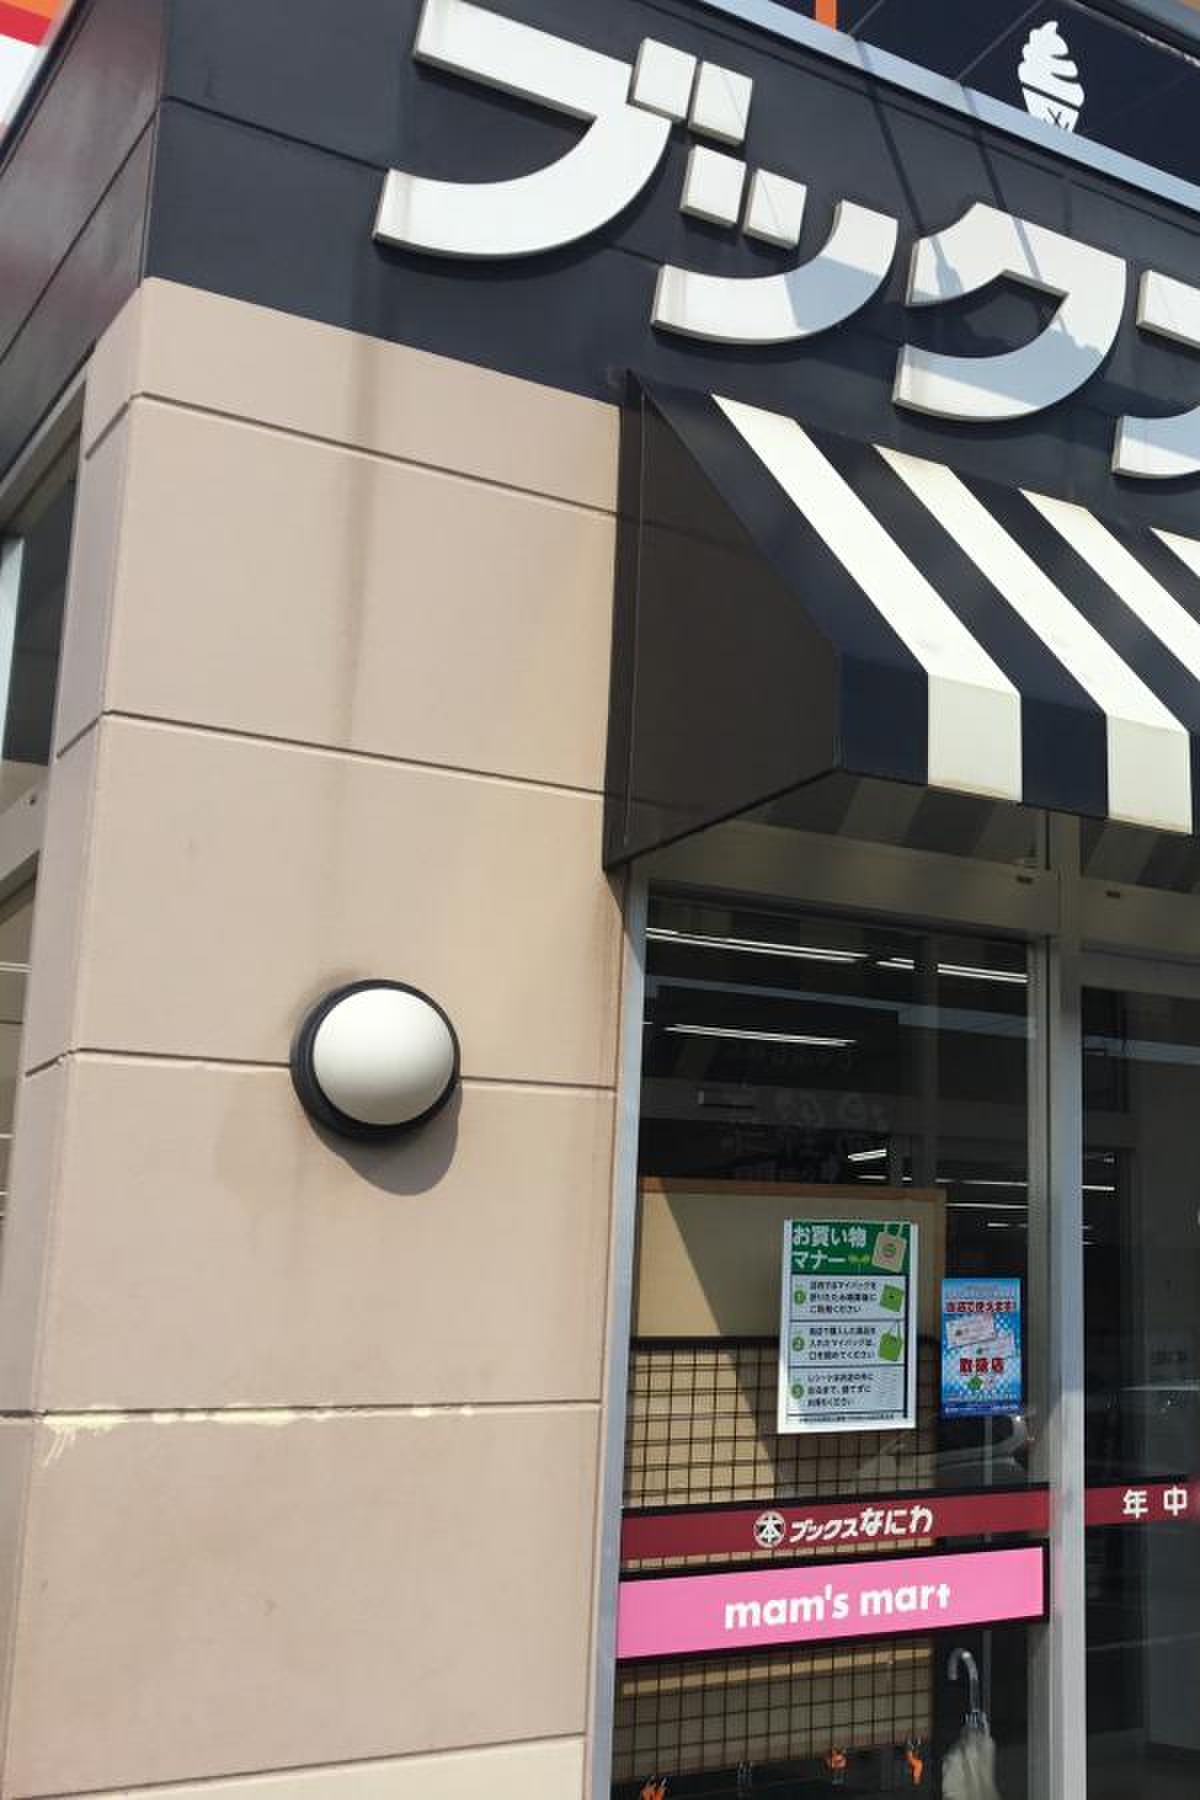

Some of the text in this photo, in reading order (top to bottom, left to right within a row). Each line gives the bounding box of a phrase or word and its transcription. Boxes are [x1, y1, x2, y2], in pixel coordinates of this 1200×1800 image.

[793, 1225, 866, 1248] お買い物
[792, 1250, 846, 1269] マナー
[725, 1583, 950, 1629] mam's mart
